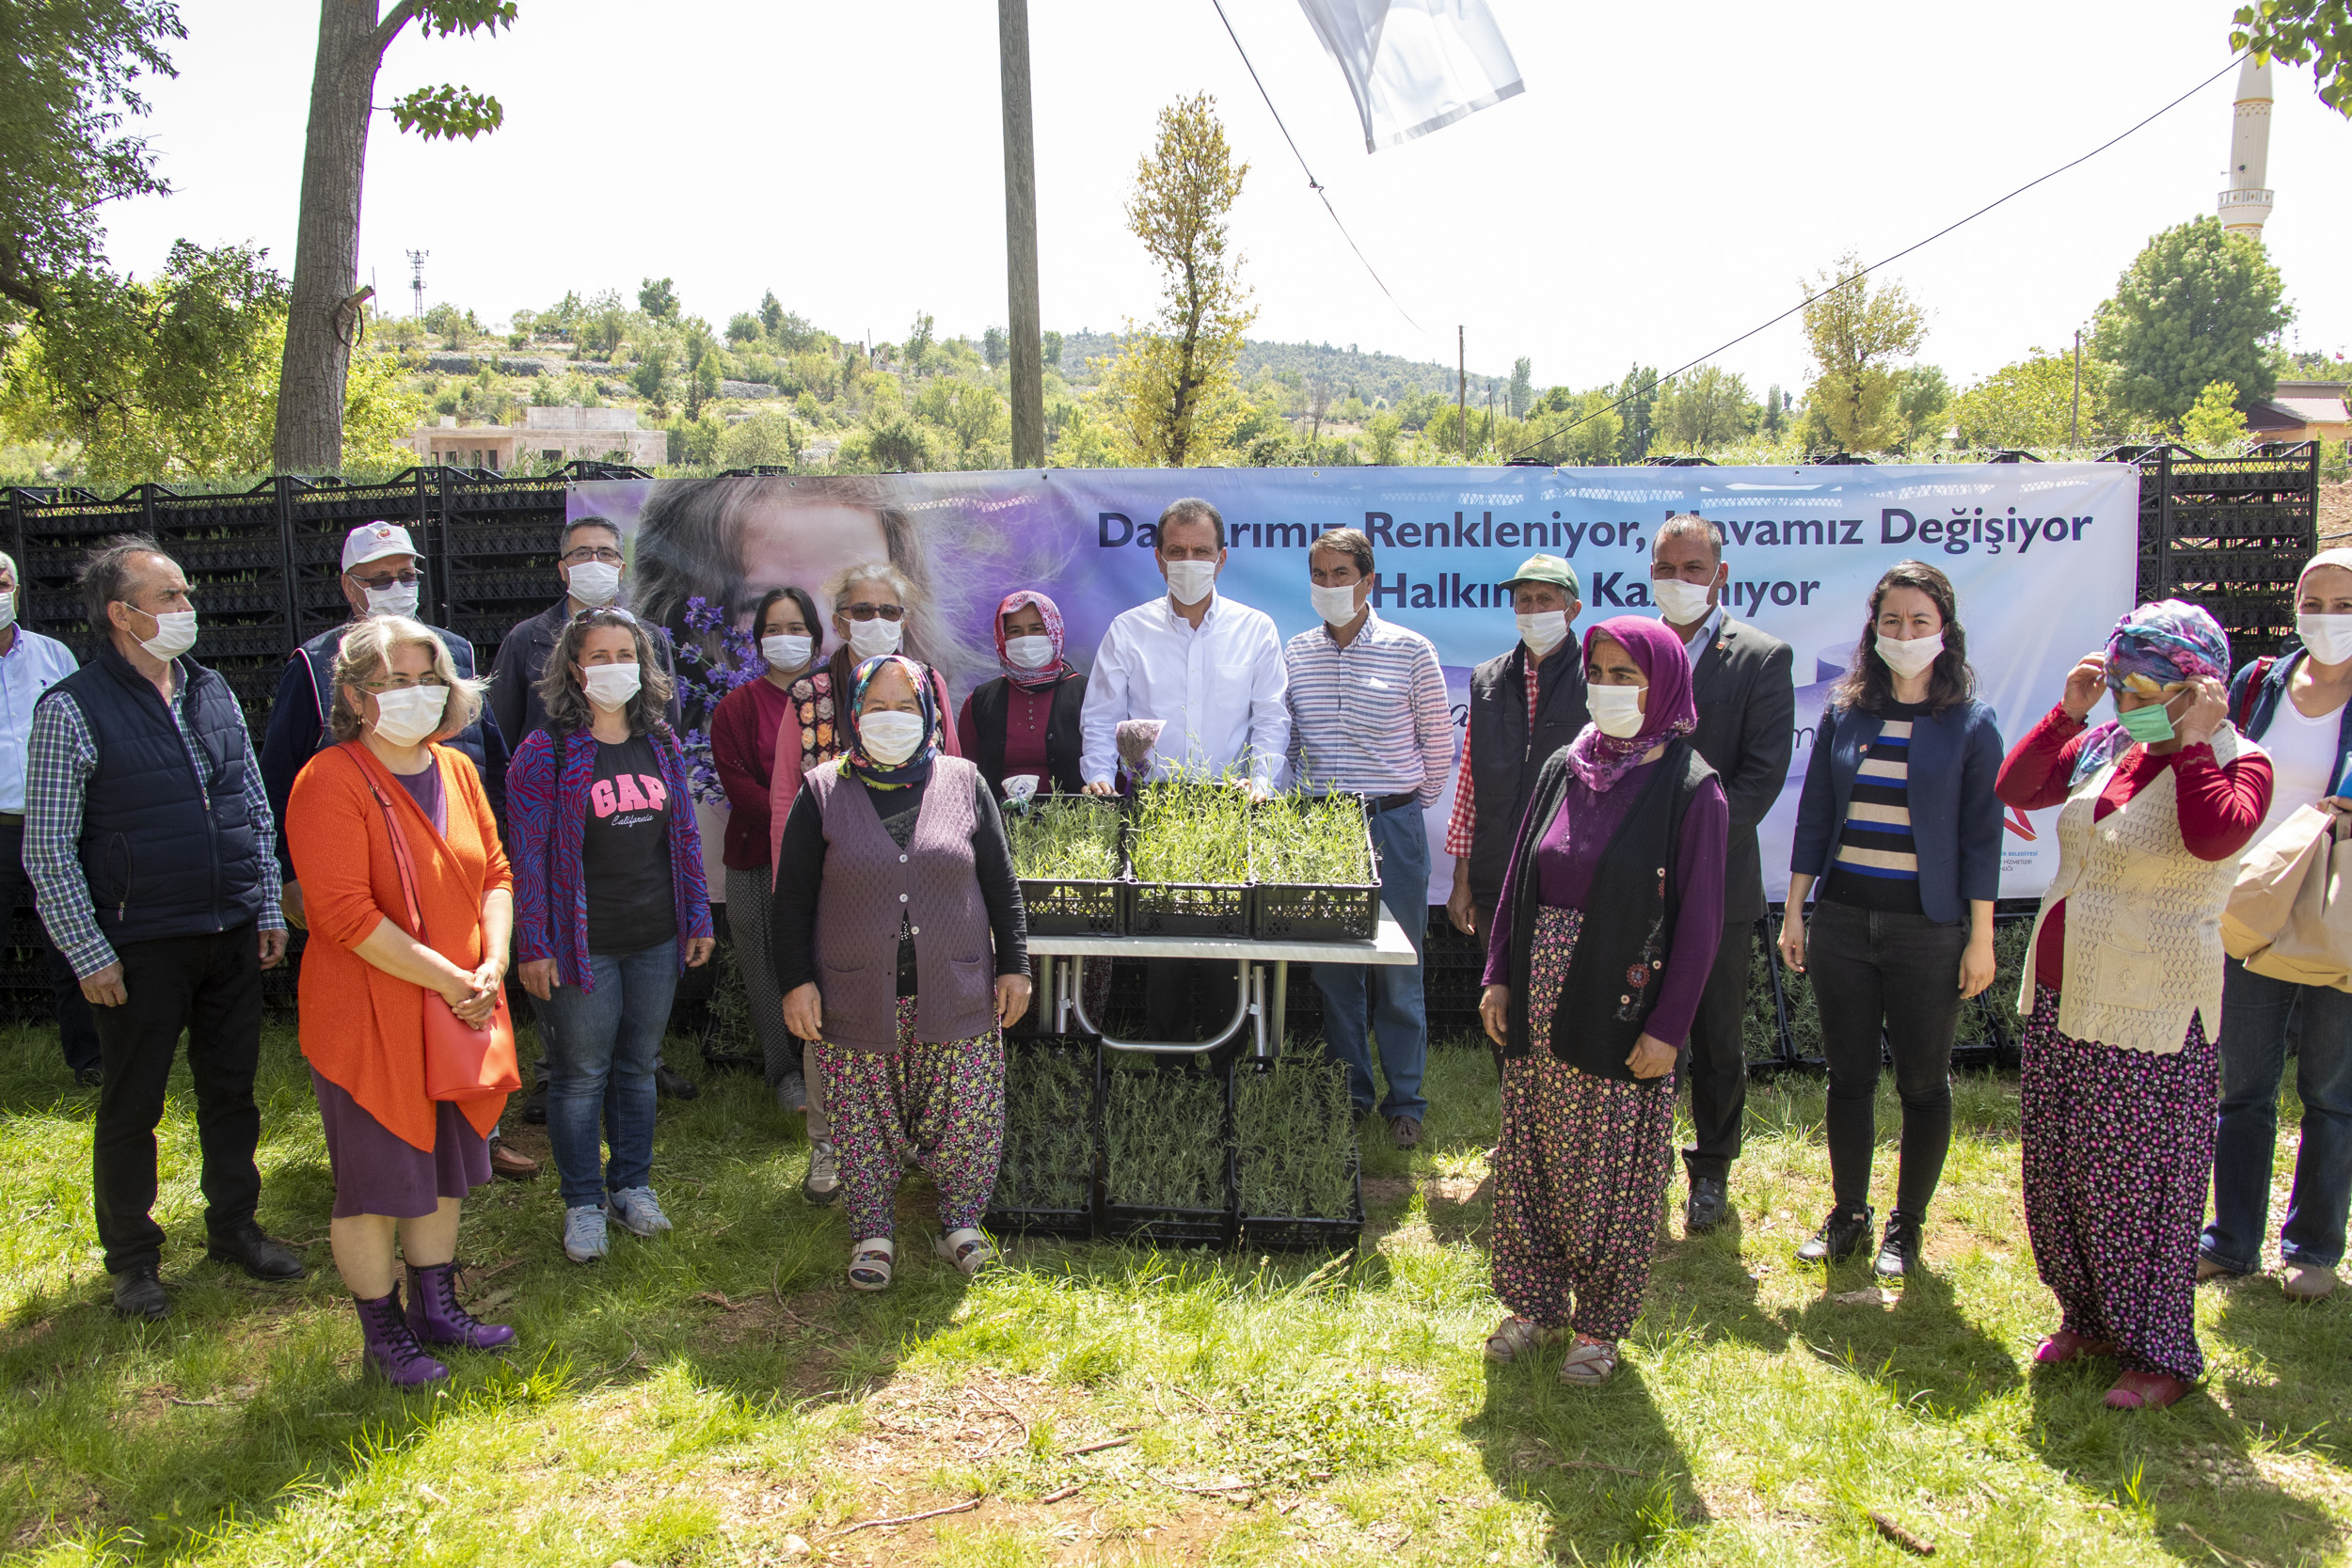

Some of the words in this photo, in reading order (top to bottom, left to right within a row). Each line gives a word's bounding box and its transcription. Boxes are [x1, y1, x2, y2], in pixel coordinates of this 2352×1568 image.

[1098, 513, 1347, 548] Darımı
[1364, 511, 1646, 558] Renkleniyor,
[1881, 506, 2094, 555] Değişiyor
[591, 773, 667, 818] GAP
[612, 814, 654, 828] California
